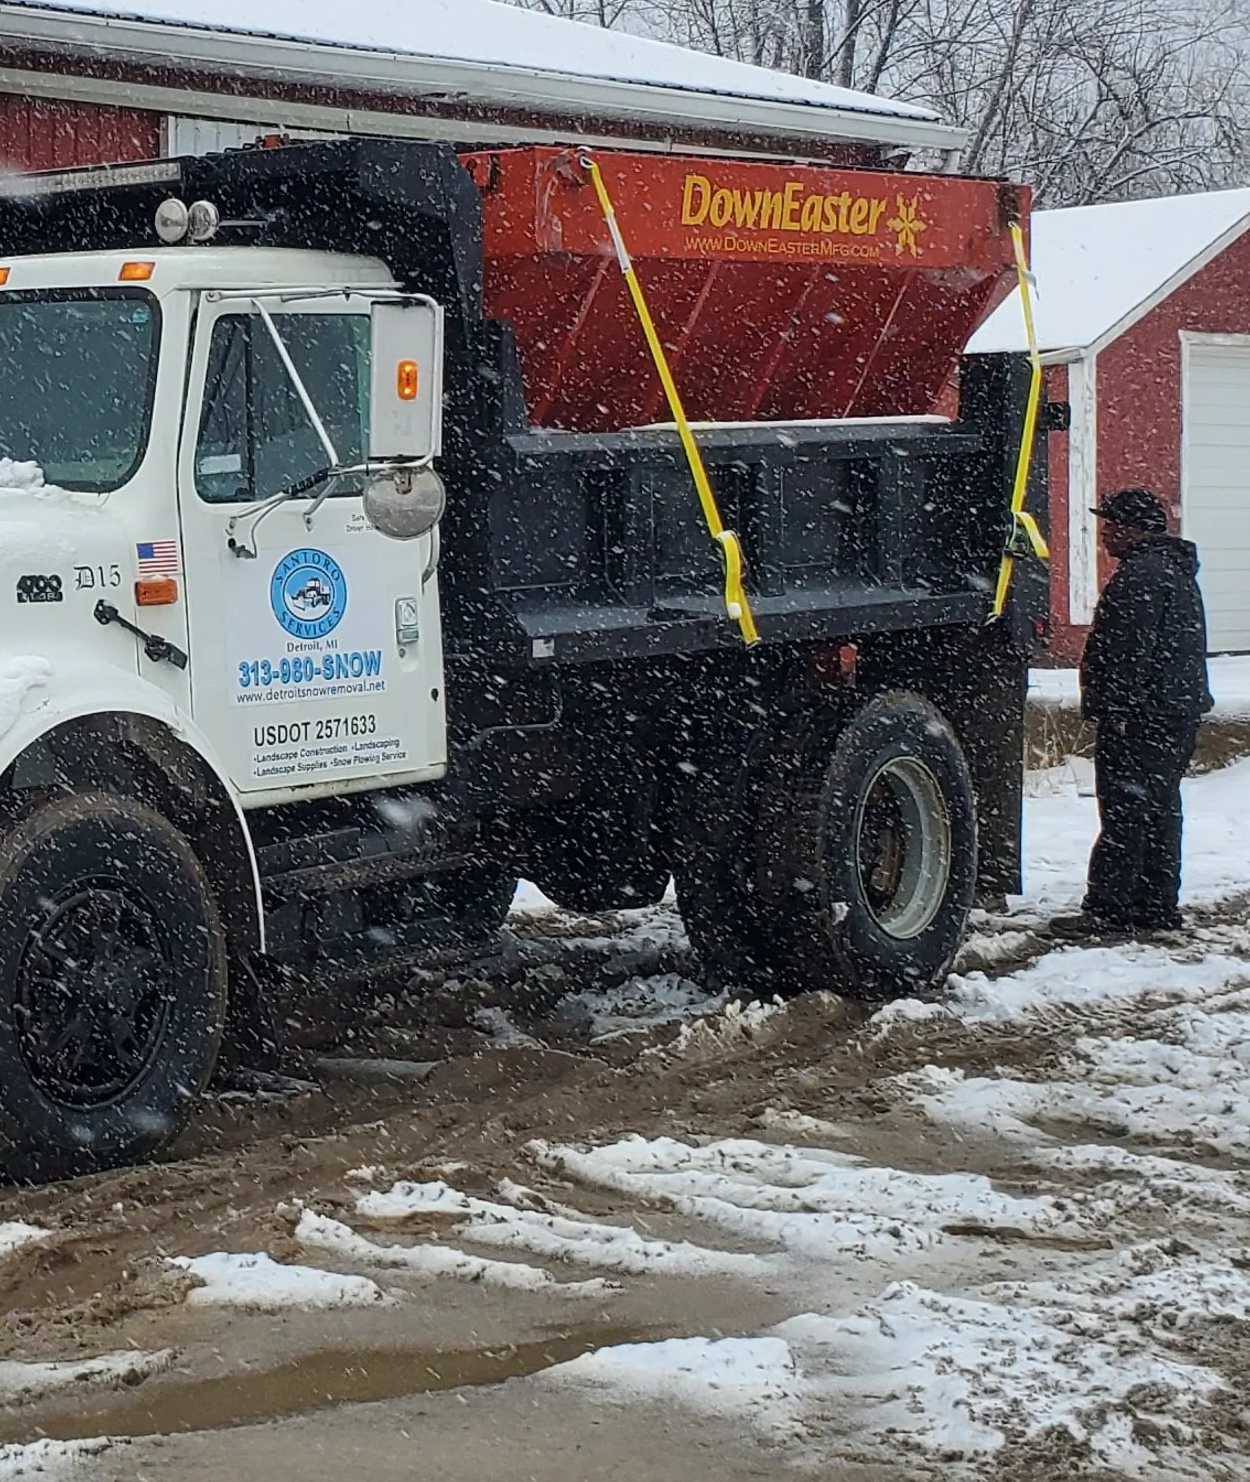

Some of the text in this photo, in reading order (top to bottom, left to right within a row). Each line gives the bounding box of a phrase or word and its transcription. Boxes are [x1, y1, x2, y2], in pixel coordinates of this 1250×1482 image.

[681, 174, 887, 235] DownEaster
[73, 564, 121, 591] D15
[275, 552, 340, 584] SANTORO
[281, 607, 340, 636] SERVICES
[287, 639, 338, 653] Detroit, MI
[238, 650, 382, 687] 313-980-SNOW
[236, 680, 385, 703] www.detroitsnowremoval.net
[254, 714, 376, 747] USDOT 2571633
